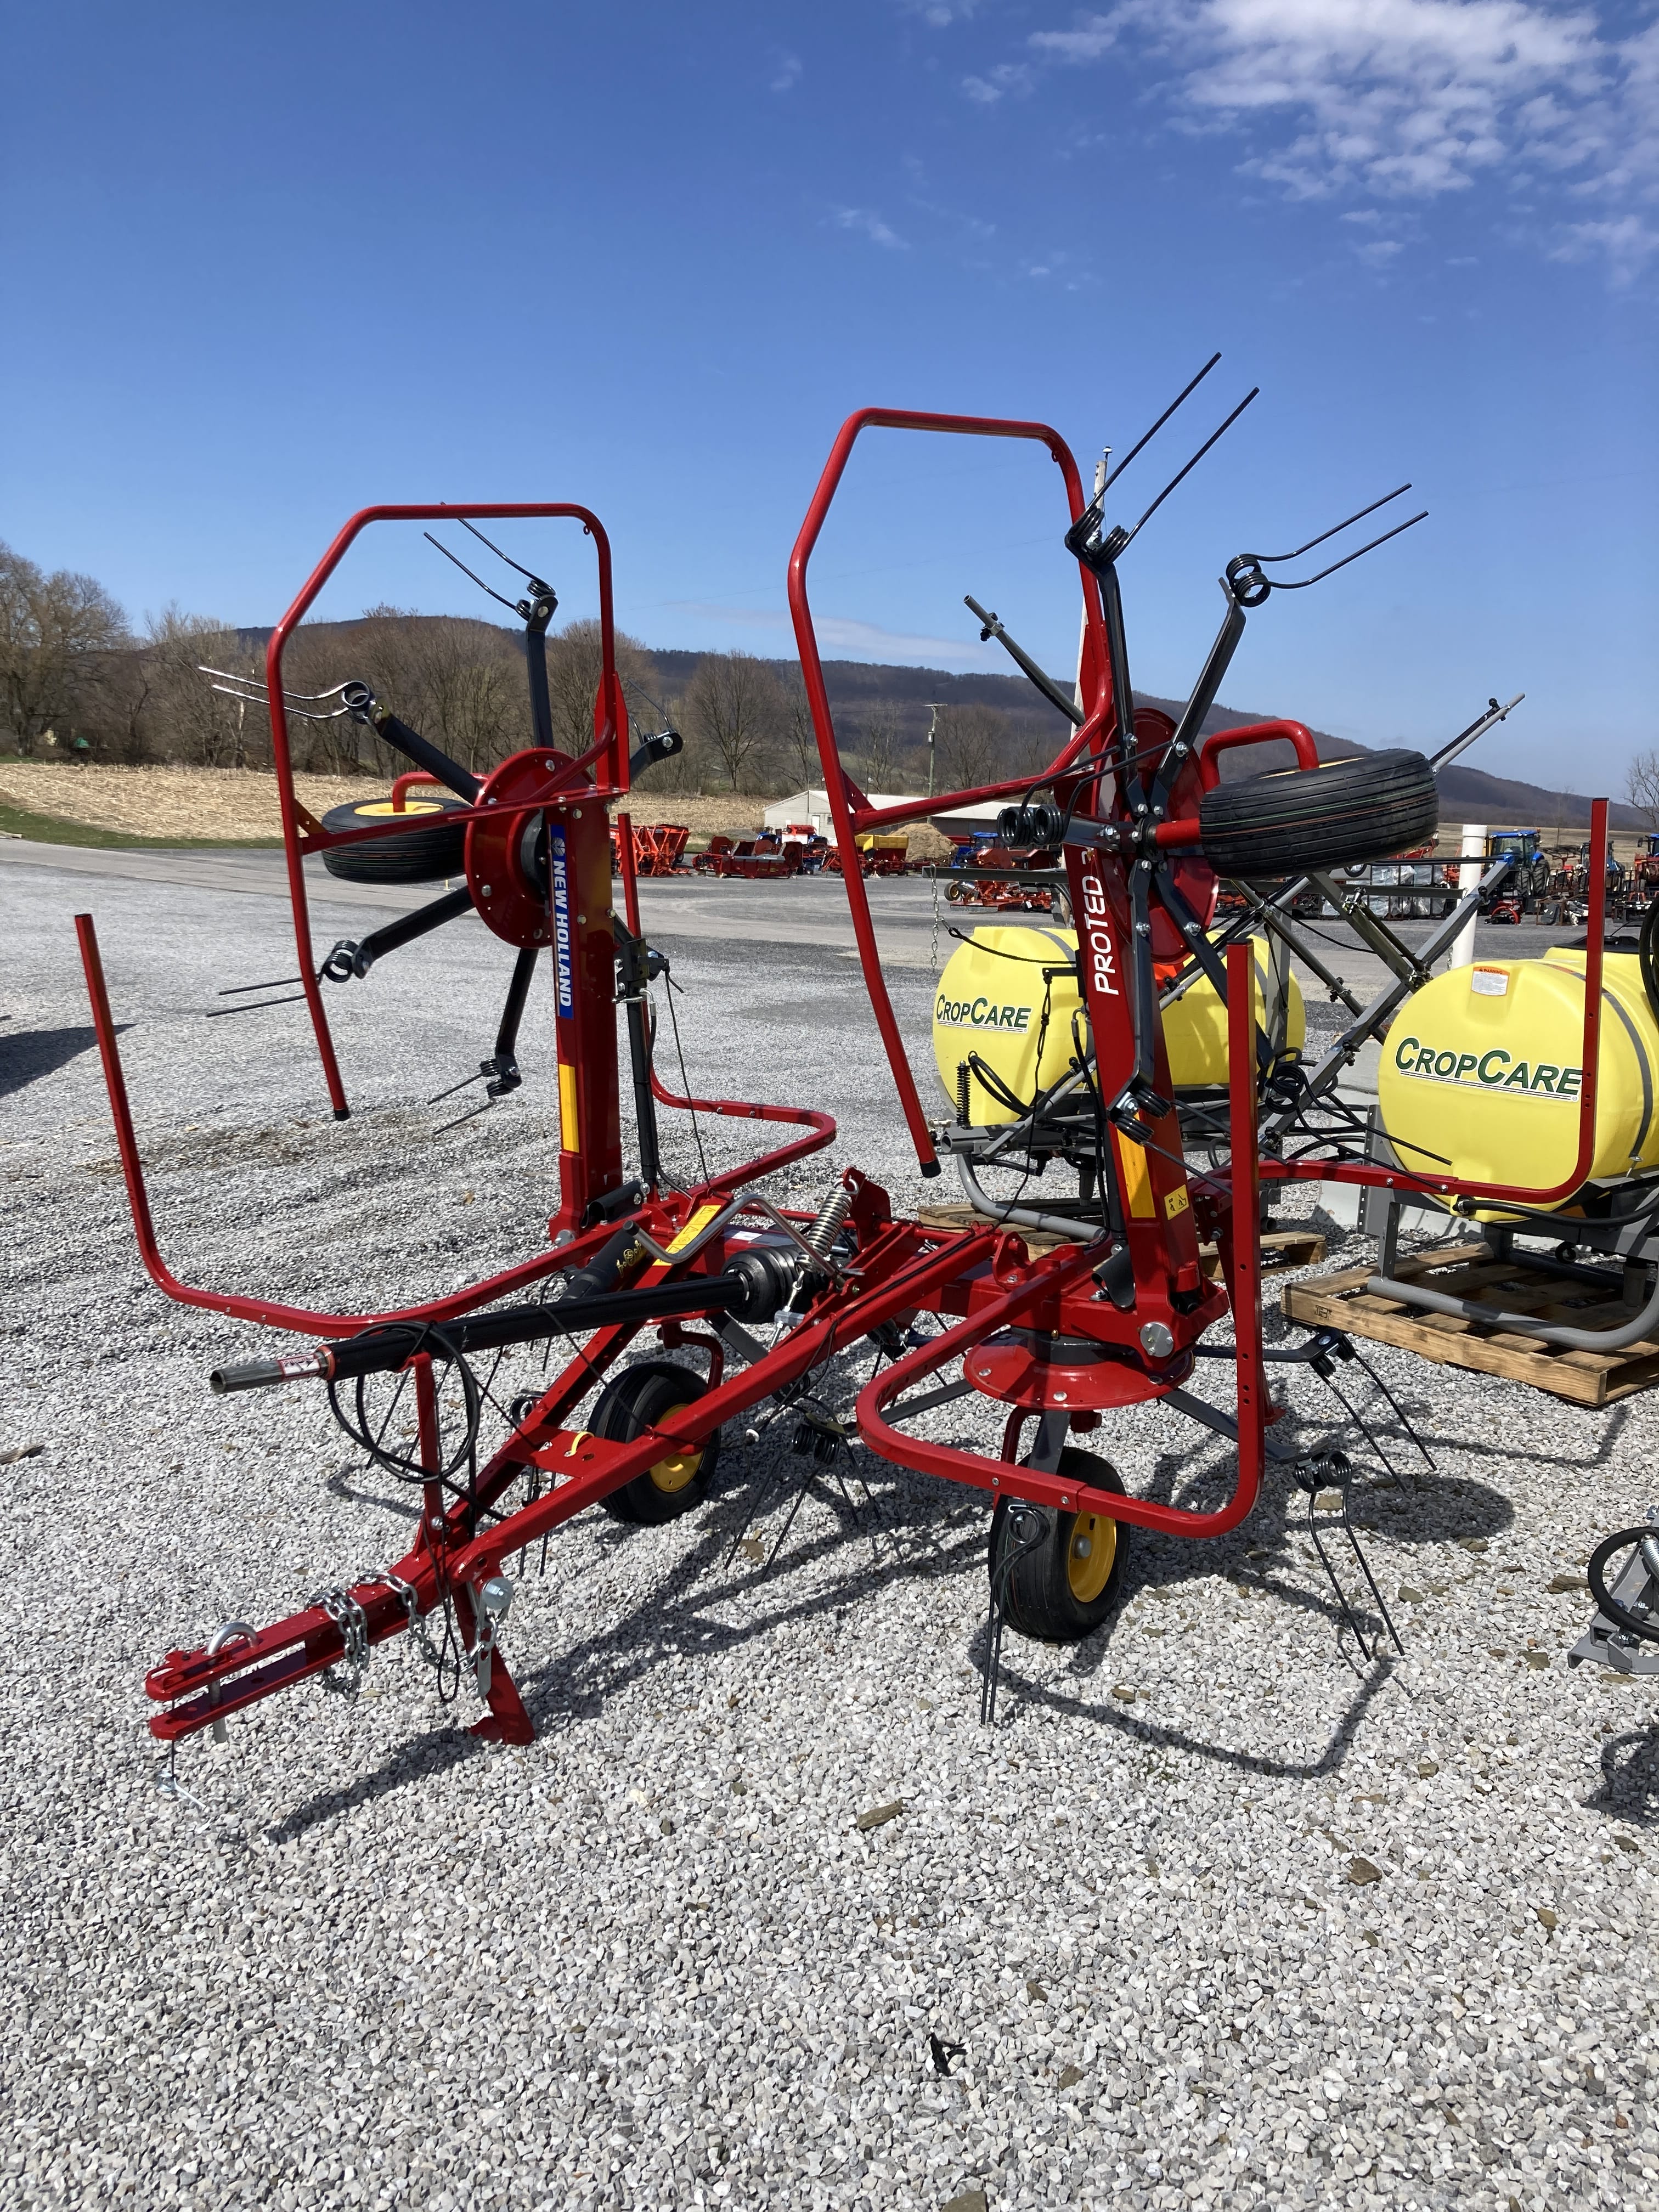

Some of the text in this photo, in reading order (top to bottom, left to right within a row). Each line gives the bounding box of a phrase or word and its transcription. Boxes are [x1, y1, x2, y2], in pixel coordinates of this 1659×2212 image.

[553, 860, 572, 1007] NEW HOLLAND
[1081, 875, 1119, 995] PROTED
